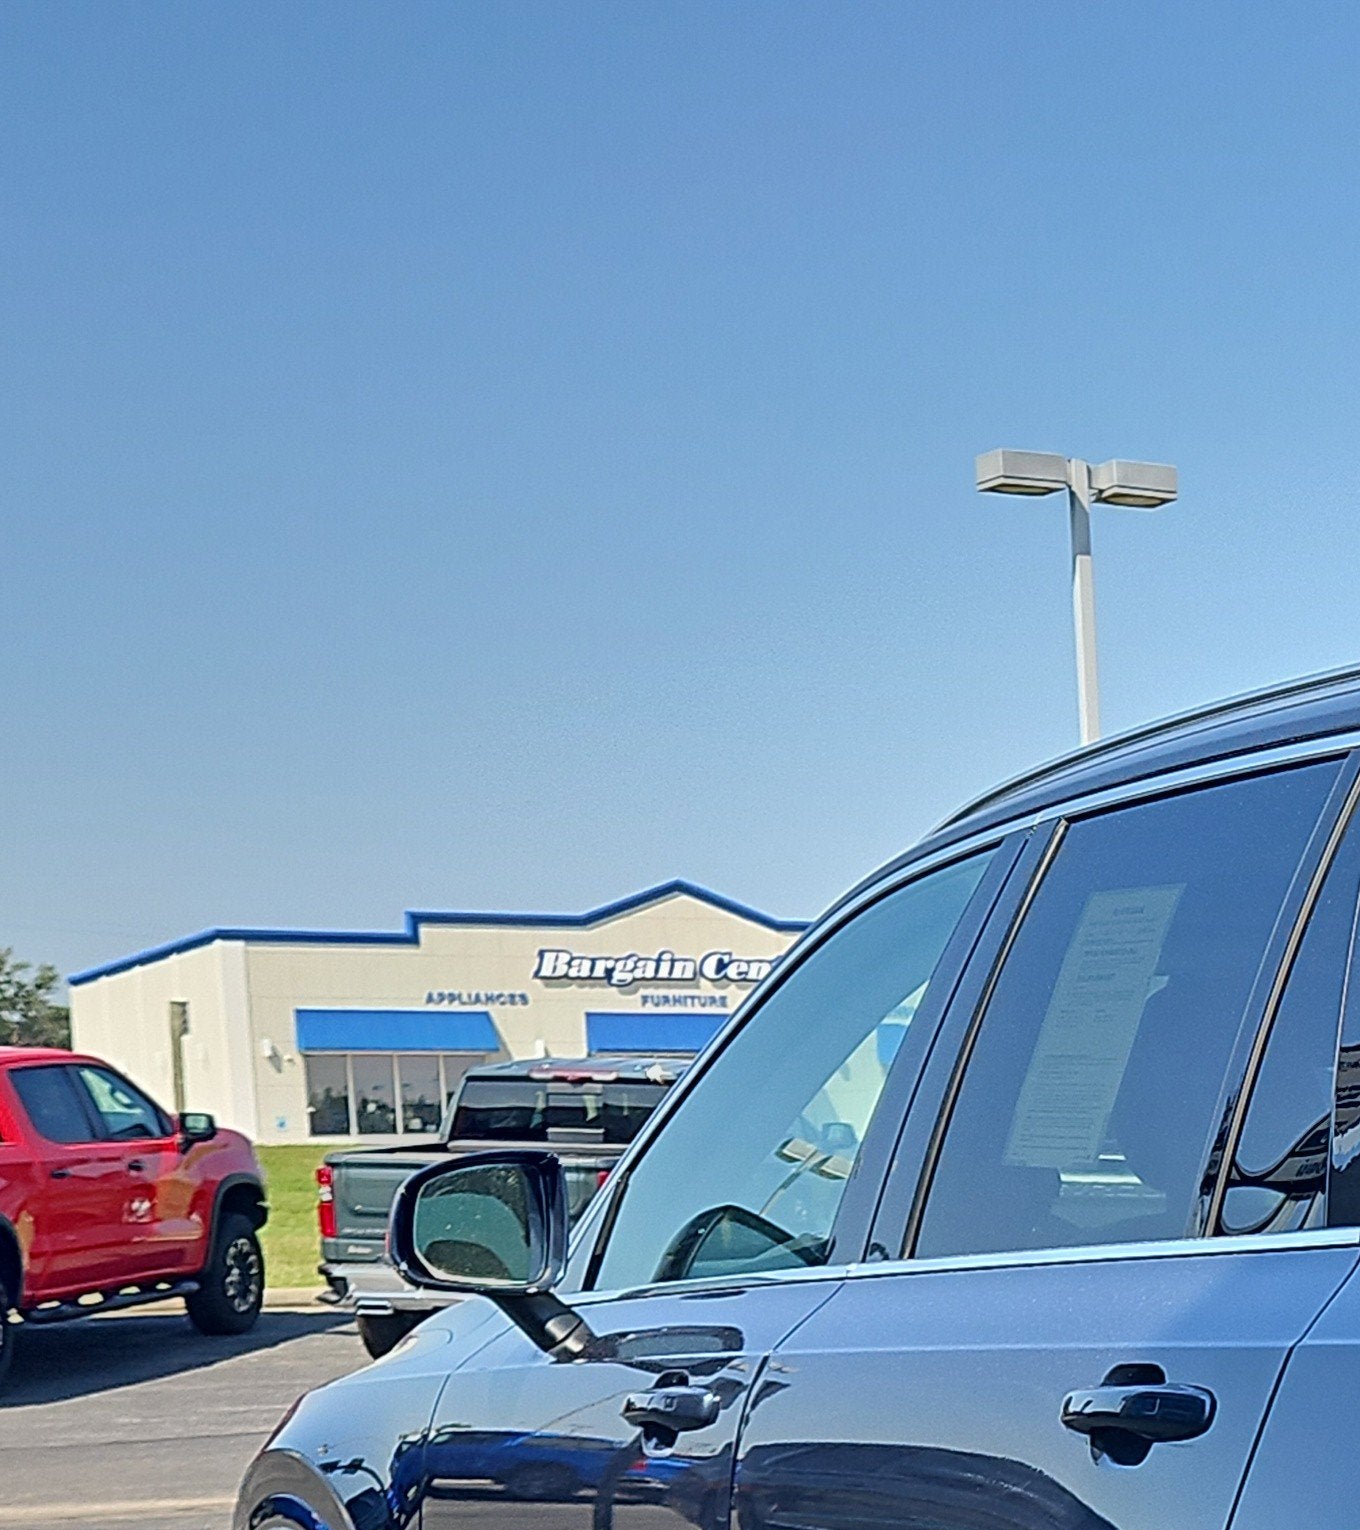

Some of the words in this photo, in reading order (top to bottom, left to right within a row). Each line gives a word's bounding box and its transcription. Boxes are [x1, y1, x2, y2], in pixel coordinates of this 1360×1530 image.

[534, 948, 699, 987] Bargain
[701, 951, 777, 982] Cen
[425, 991, 530, 1007] APPLIANCES
[641, 994, 729, 1008] FURNITURE
